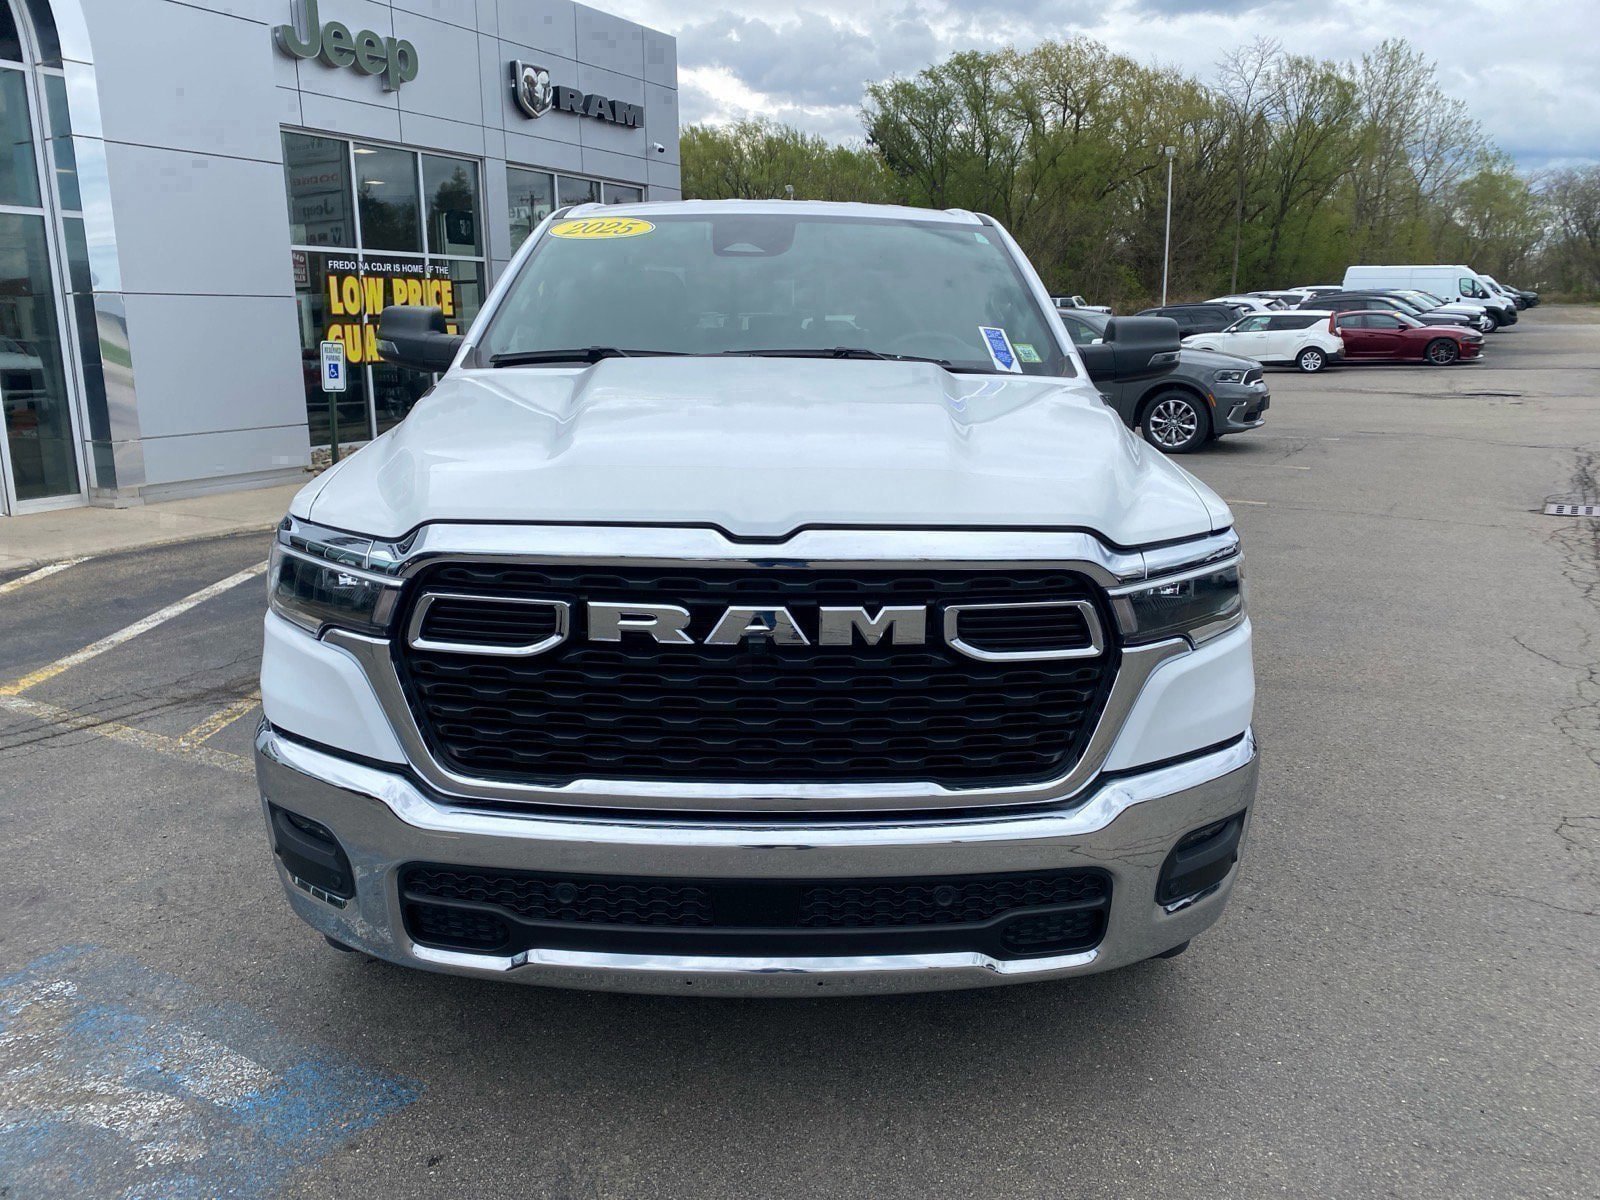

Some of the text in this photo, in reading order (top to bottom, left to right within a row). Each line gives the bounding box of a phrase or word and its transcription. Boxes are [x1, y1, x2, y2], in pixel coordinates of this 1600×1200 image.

[271, 0, 419, 92] Jeep
[552, 85, 644, 128] RAM
[569, 221, 640, 235] 2025
[371, 262, 392, 272] CDJR
[393, 264, 400, 272] IS
[402, 264, 423, 273] HOME
[435, 265, 449, 275] THE
[328, 275, 455, 316] LOW PRICE
[587, 601, 928, 647] RAM
